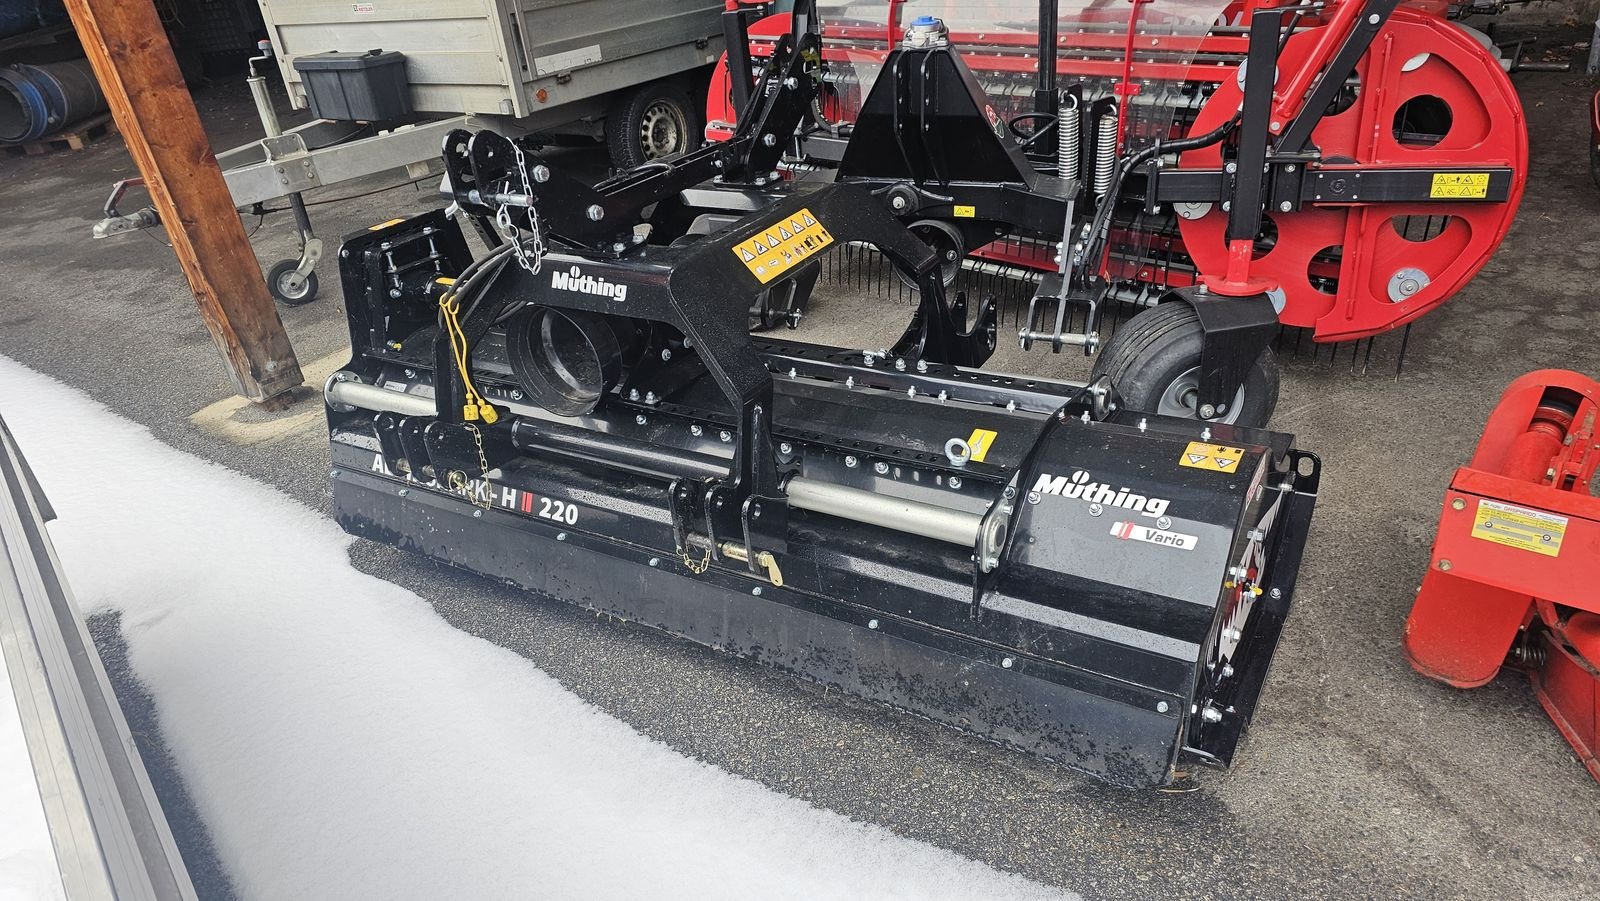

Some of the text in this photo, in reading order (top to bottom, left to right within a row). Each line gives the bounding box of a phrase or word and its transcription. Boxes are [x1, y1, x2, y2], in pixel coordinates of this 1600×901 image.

[551, 265, 627, 302] Müthing
[1031, 470, 1170, 518] Müthing
[538, 497, 578, 526] 220
[1145, 529, 1185, 547] Vario
